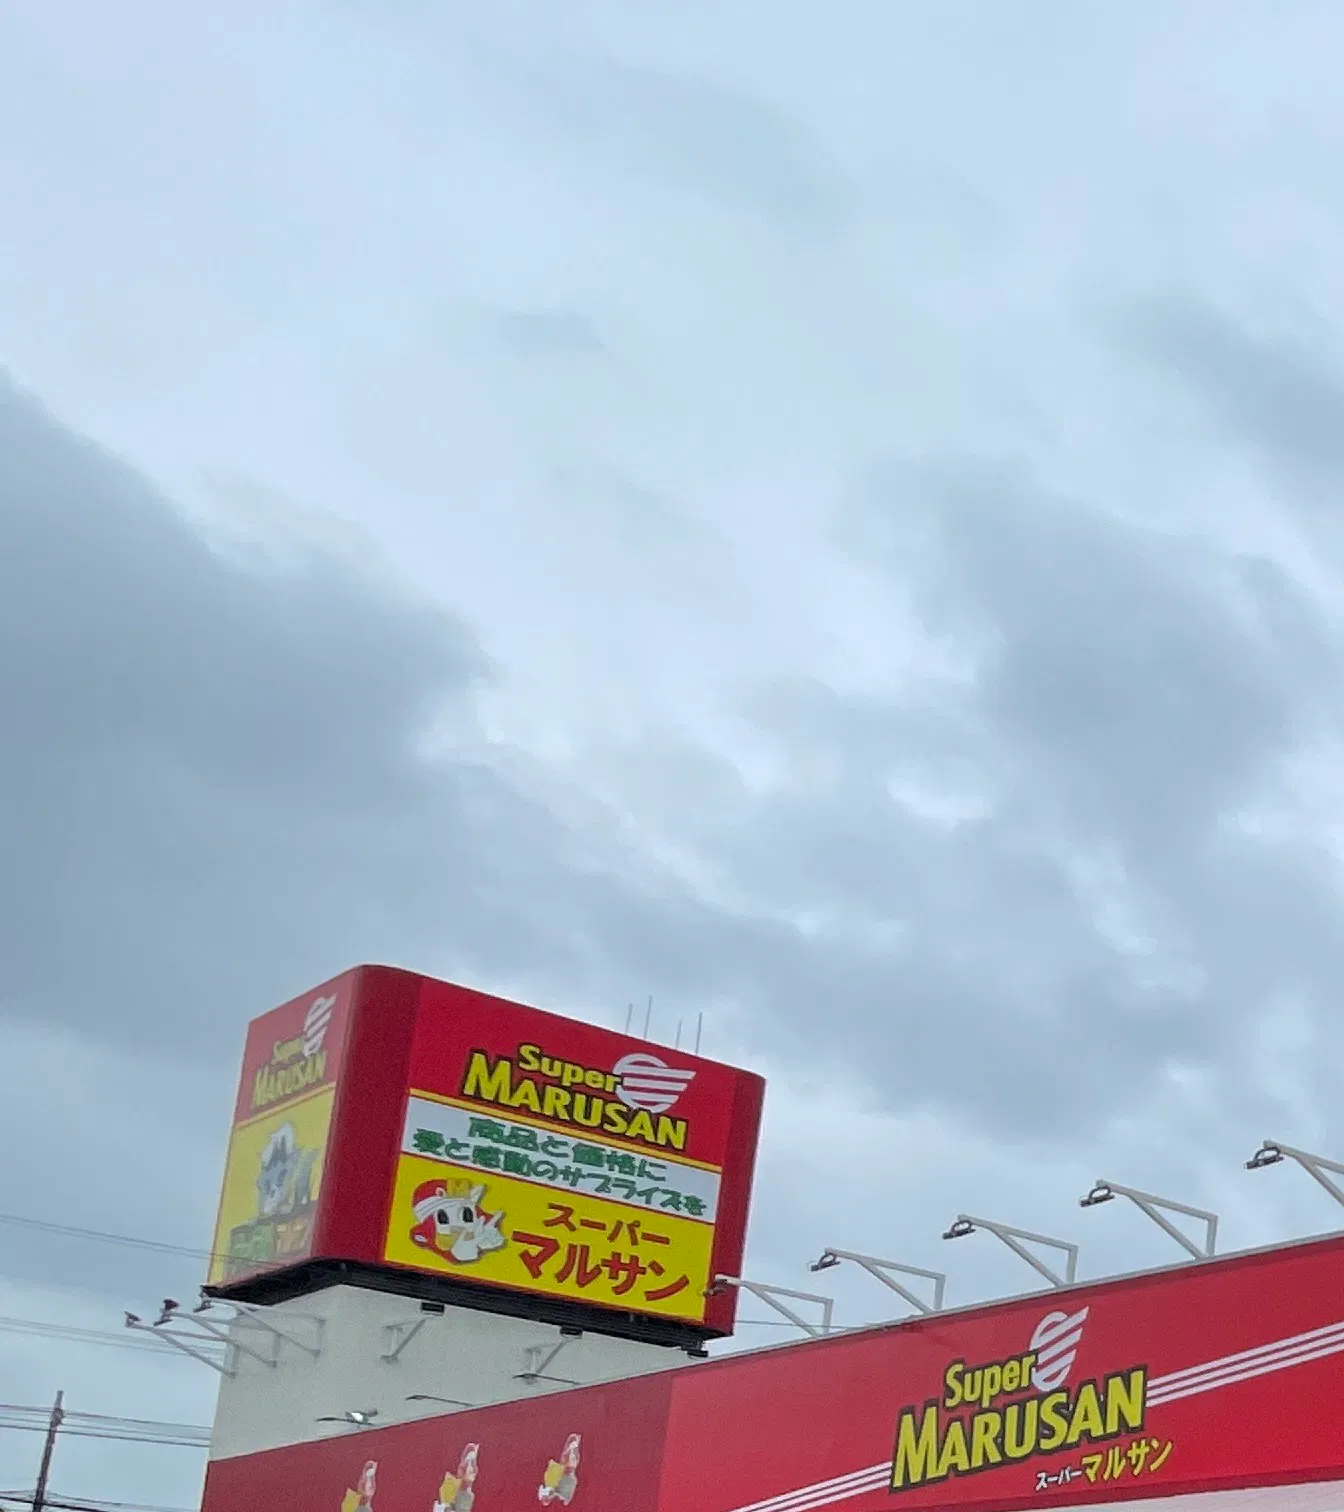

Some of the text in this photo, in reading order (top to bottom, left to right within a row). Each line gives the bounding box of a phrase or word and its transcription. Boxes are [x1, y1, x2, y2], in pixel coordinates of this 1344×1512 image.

[518, 1044, 622, 1093] Super
[463, 1052, 688, 1149] MARUSAN
[542, 1203, 671, 1245] スーパー
[511, 1231, 690, 1301] マルサン
[944, 1353, 1037, 1408] Super
[892, 1370, 1145, 1489] MARUSAN
